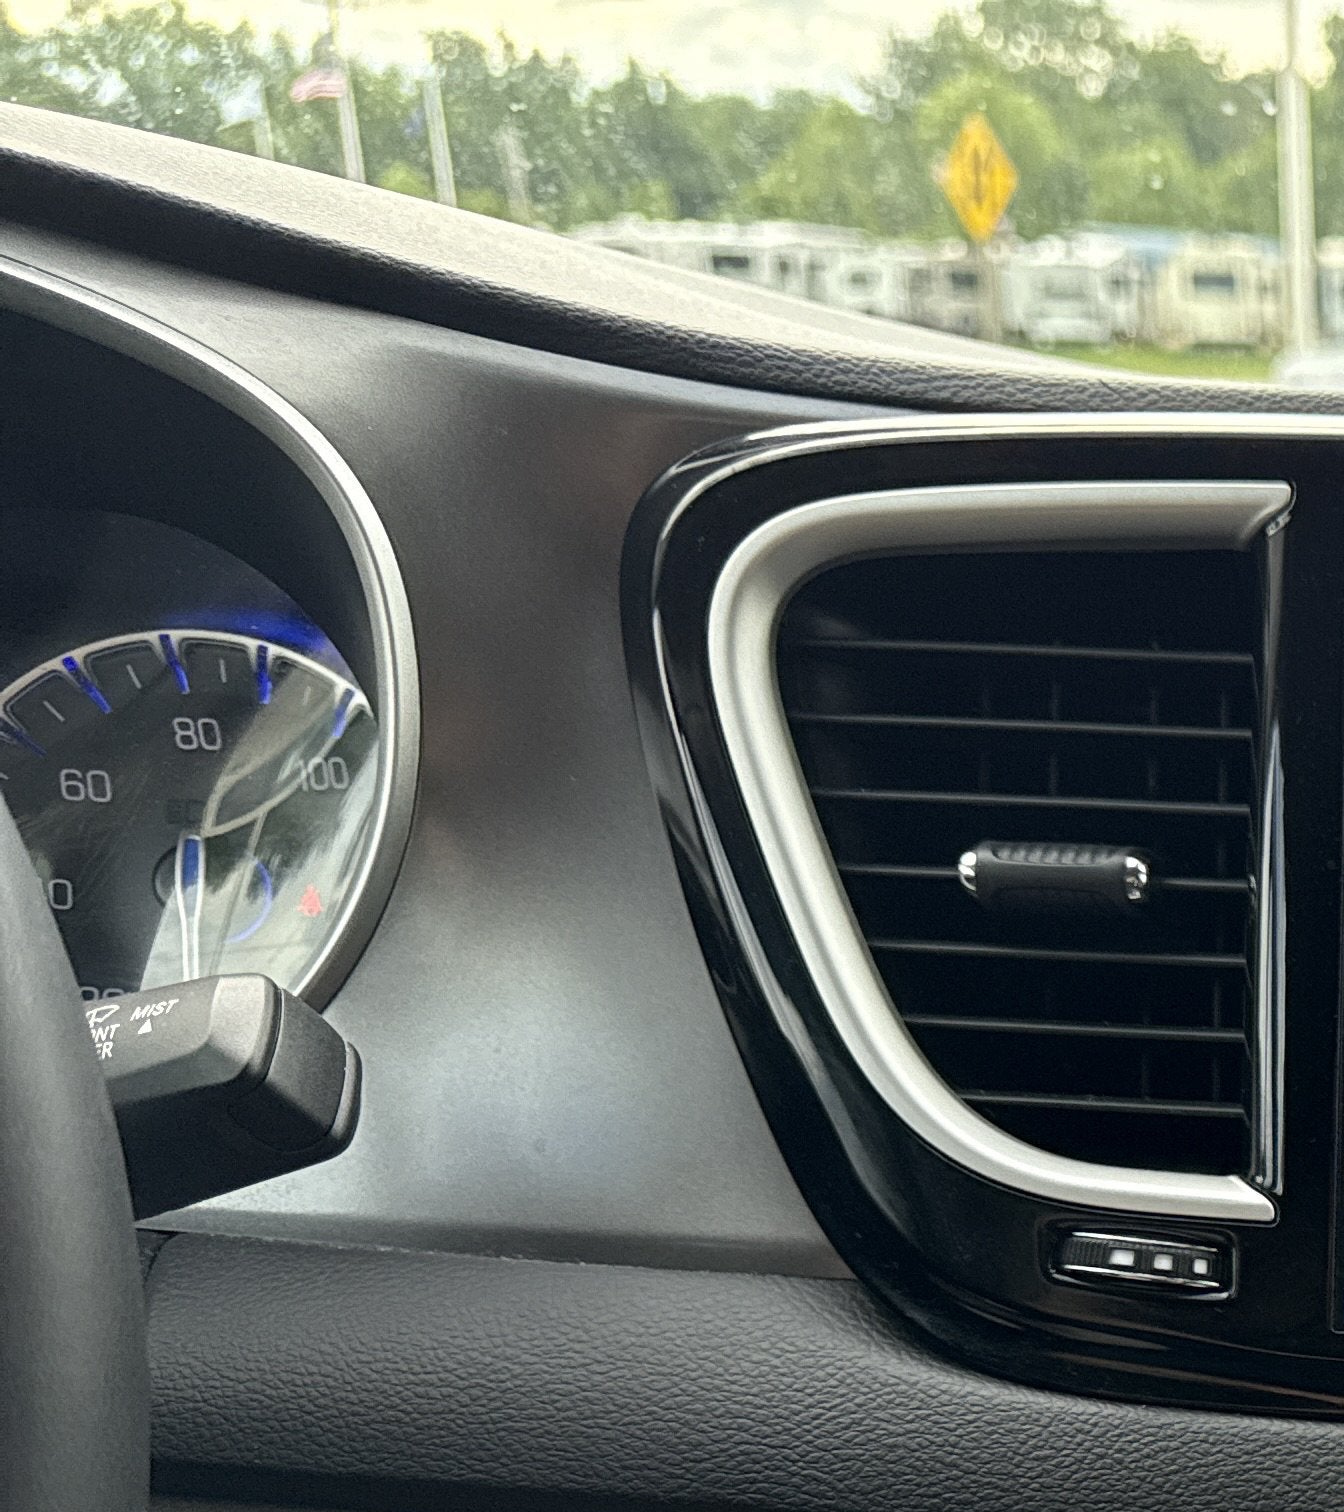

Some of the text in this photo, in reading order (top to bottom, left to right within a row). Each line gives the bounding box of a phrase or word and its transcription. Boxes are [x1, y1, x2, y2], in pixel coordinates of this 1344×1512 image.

[172, 717, 222, 751] 80
[59, 768, 112, 803] 60
[299, 756, 349, 792] 100
[48, 878, 73, 910] 0
[130, 999, 179, 1022] MIST
